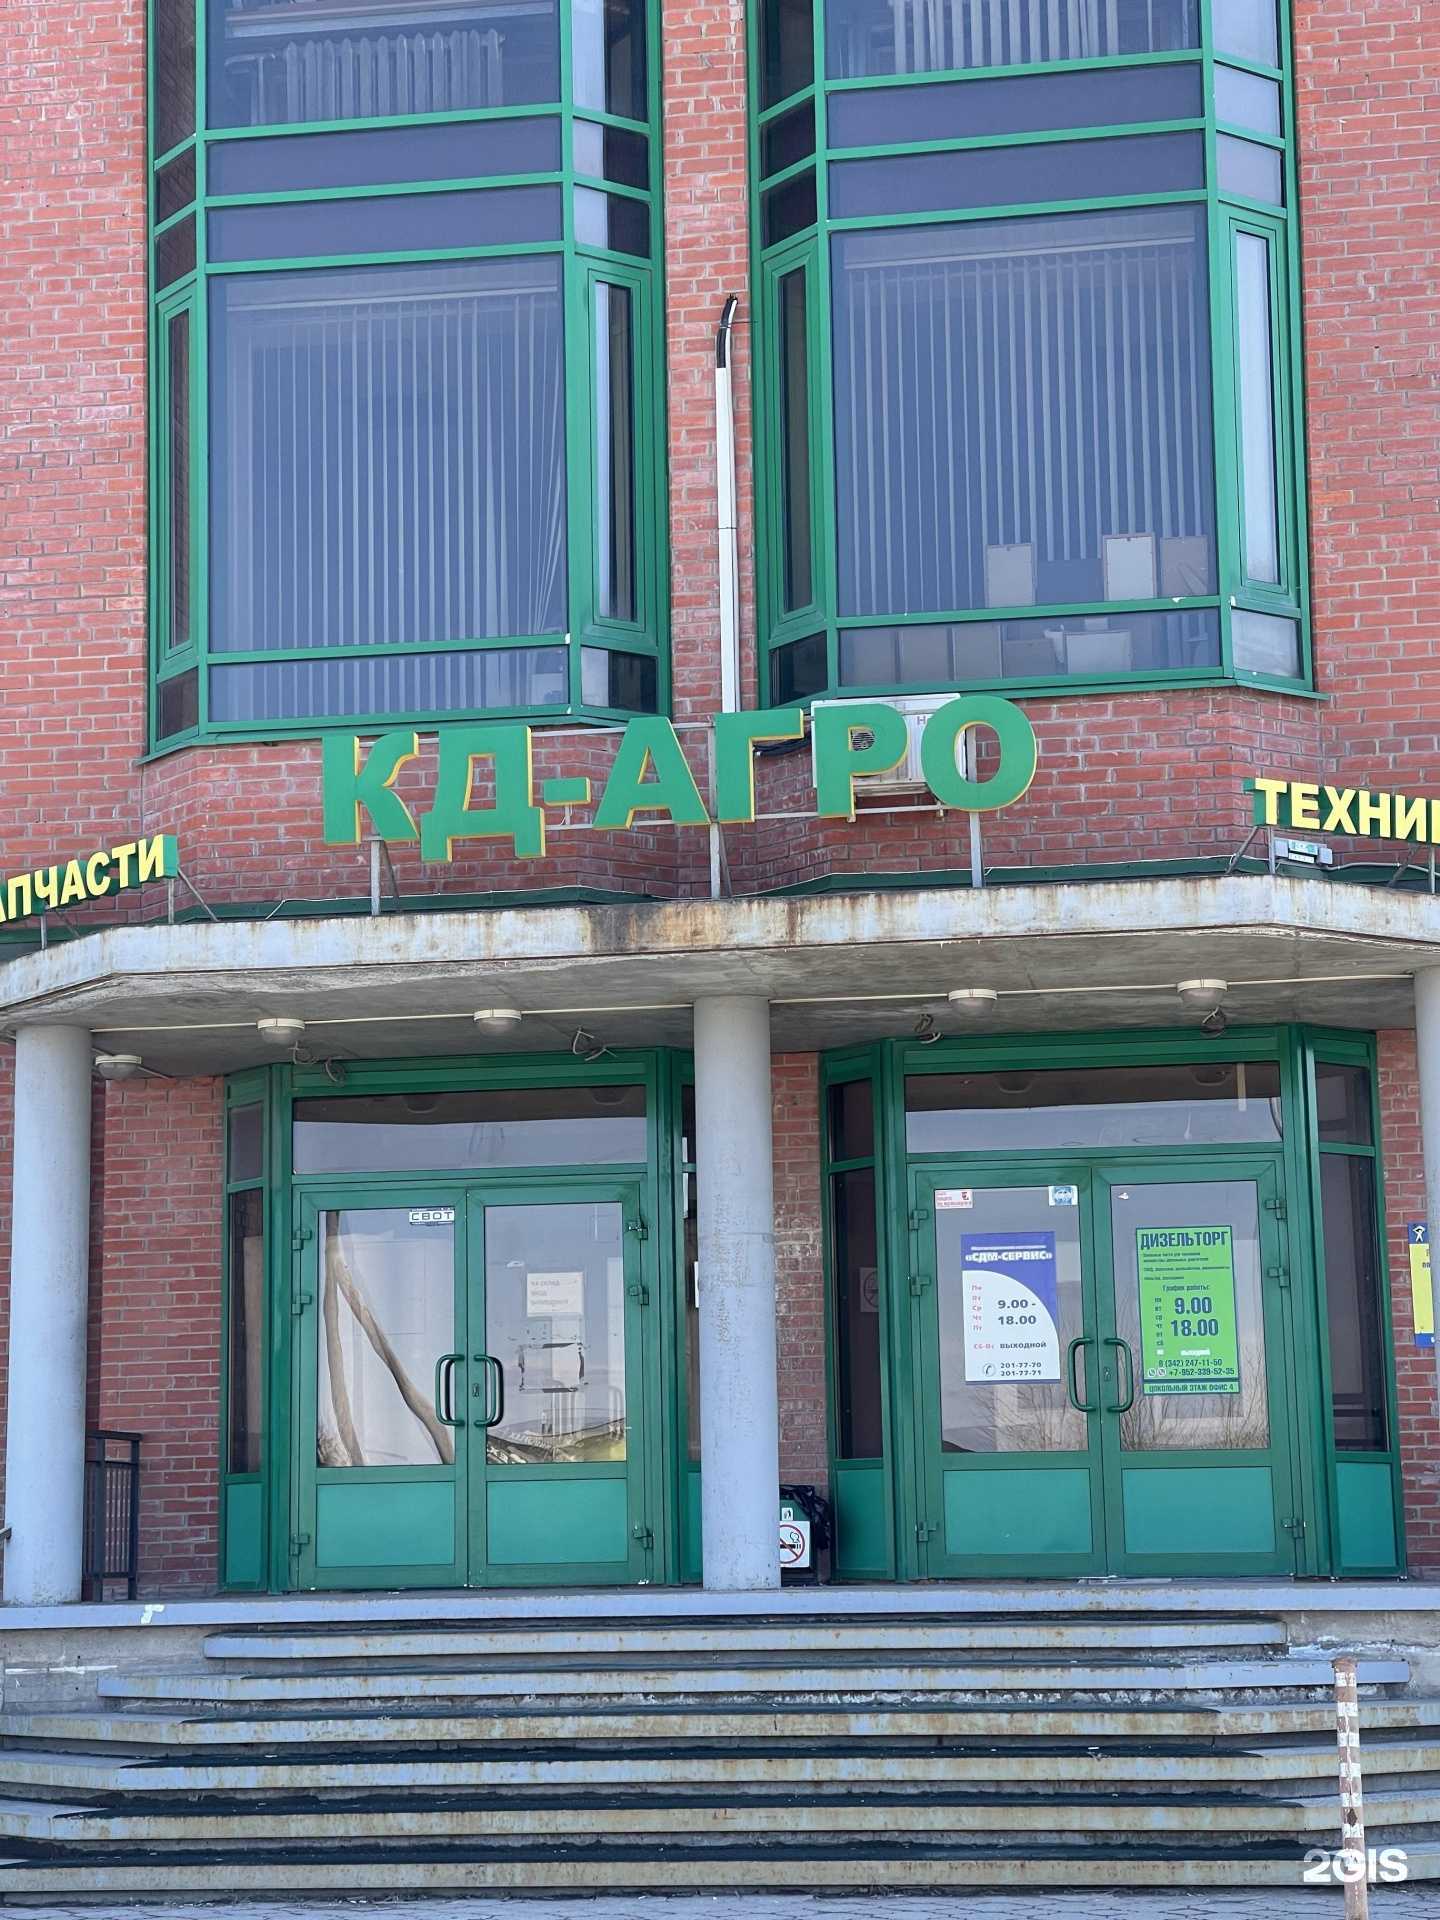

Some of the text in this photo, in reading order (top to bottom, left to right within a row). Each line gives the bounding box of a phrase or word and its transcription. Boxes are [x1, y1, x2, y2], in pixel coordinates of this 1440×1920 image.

[321, 694, 1038, 863] КД-АГРО
[1254, 777, 1440, 844] ТЕХНИ
[1140, 1231, 1229, 1250] ДИЗЕЛЬТОРГ
[997, 1299, 1029, 1309] 9.00
[1174, 1296, 1213, 1315] 9.00
[998, 1315, 1037, 1325] 18.00
[1170, 1319, 1219, 1337] 18.00
